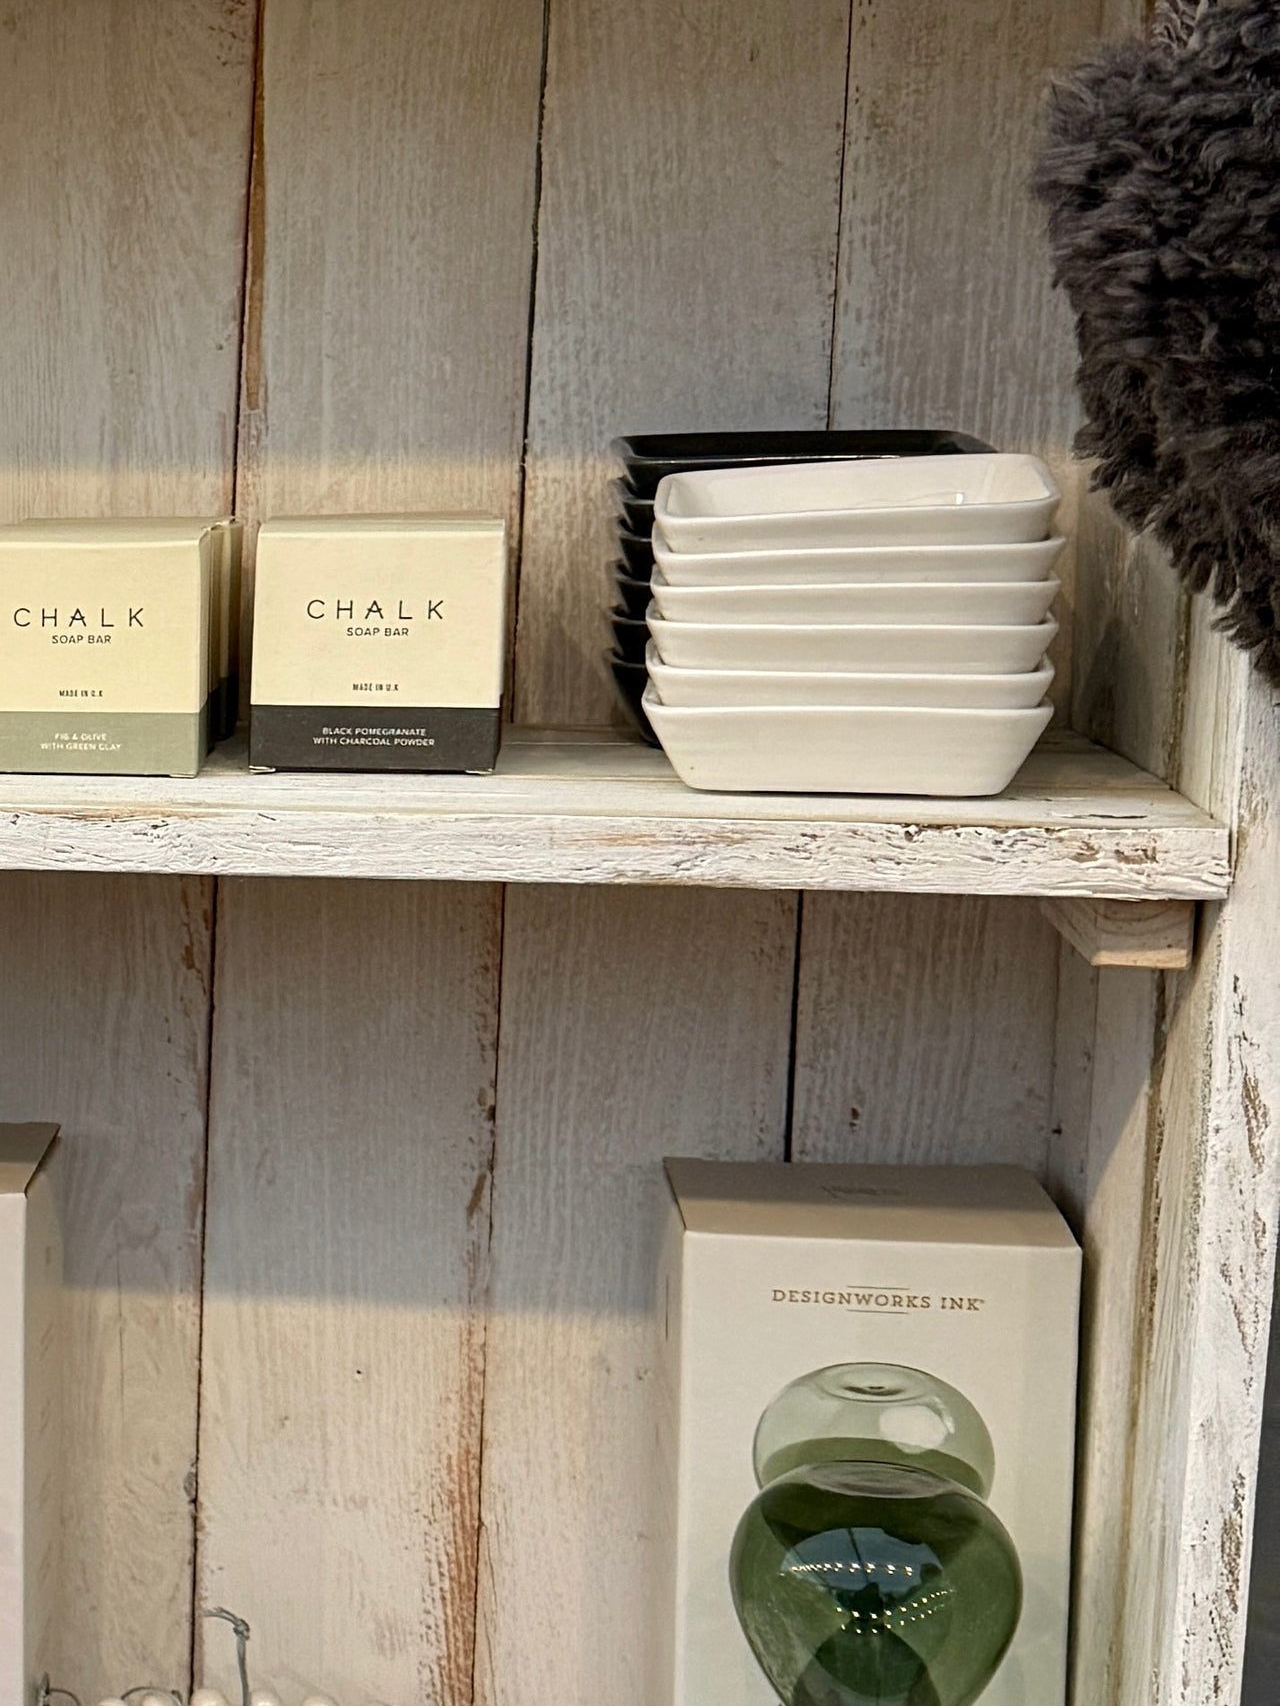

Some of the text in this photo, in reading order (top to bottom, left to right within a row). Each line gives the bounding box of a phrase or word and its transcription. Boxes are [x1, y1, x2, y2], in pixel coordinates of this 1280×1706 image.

[306, 599, 444, 620] CHALK
[13, 607, 144, 628] CHALK
[346, 627, 410, 637] SOAP BAR
[51, 635, 112, 644] SOAP BAR
[322, 727, 426, 737] BLACK POMEGRANATE
[40, 743, 64, 751] WITH
[312, 737, 436, 747] WITH CHARCOAL POWDER
[772, 1288, 931, 1309] DESIGNWORKS
